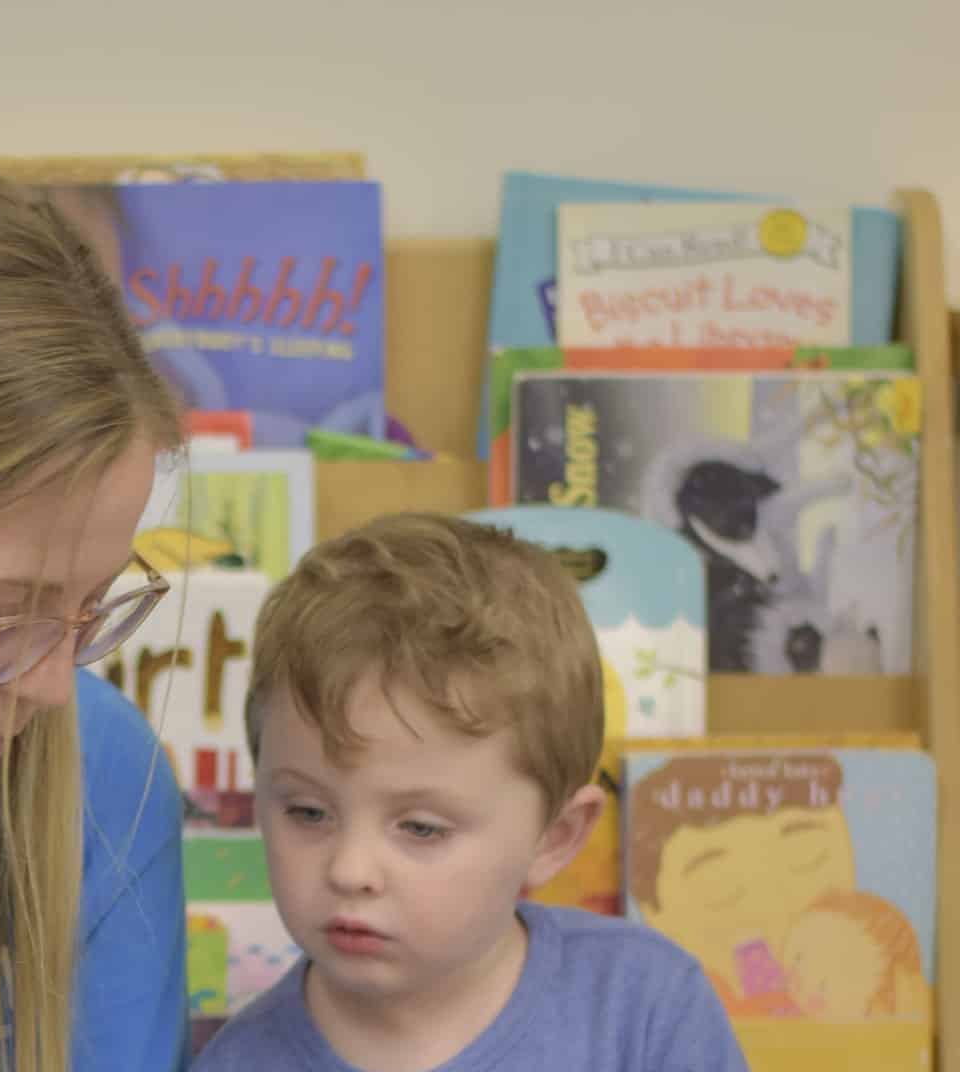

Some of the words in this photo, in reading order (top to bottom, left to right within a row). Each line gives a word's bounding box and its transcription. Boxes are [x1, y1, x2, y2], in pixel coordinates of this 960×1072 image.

[127, 255, 373, 335] Shhhhh!
[578, 272, 711, 333] Biscuit
[721, 271, 835, 328] Loves
[548, 402, 598, 508] Snow
[655, 779, 784, 815] daddy
